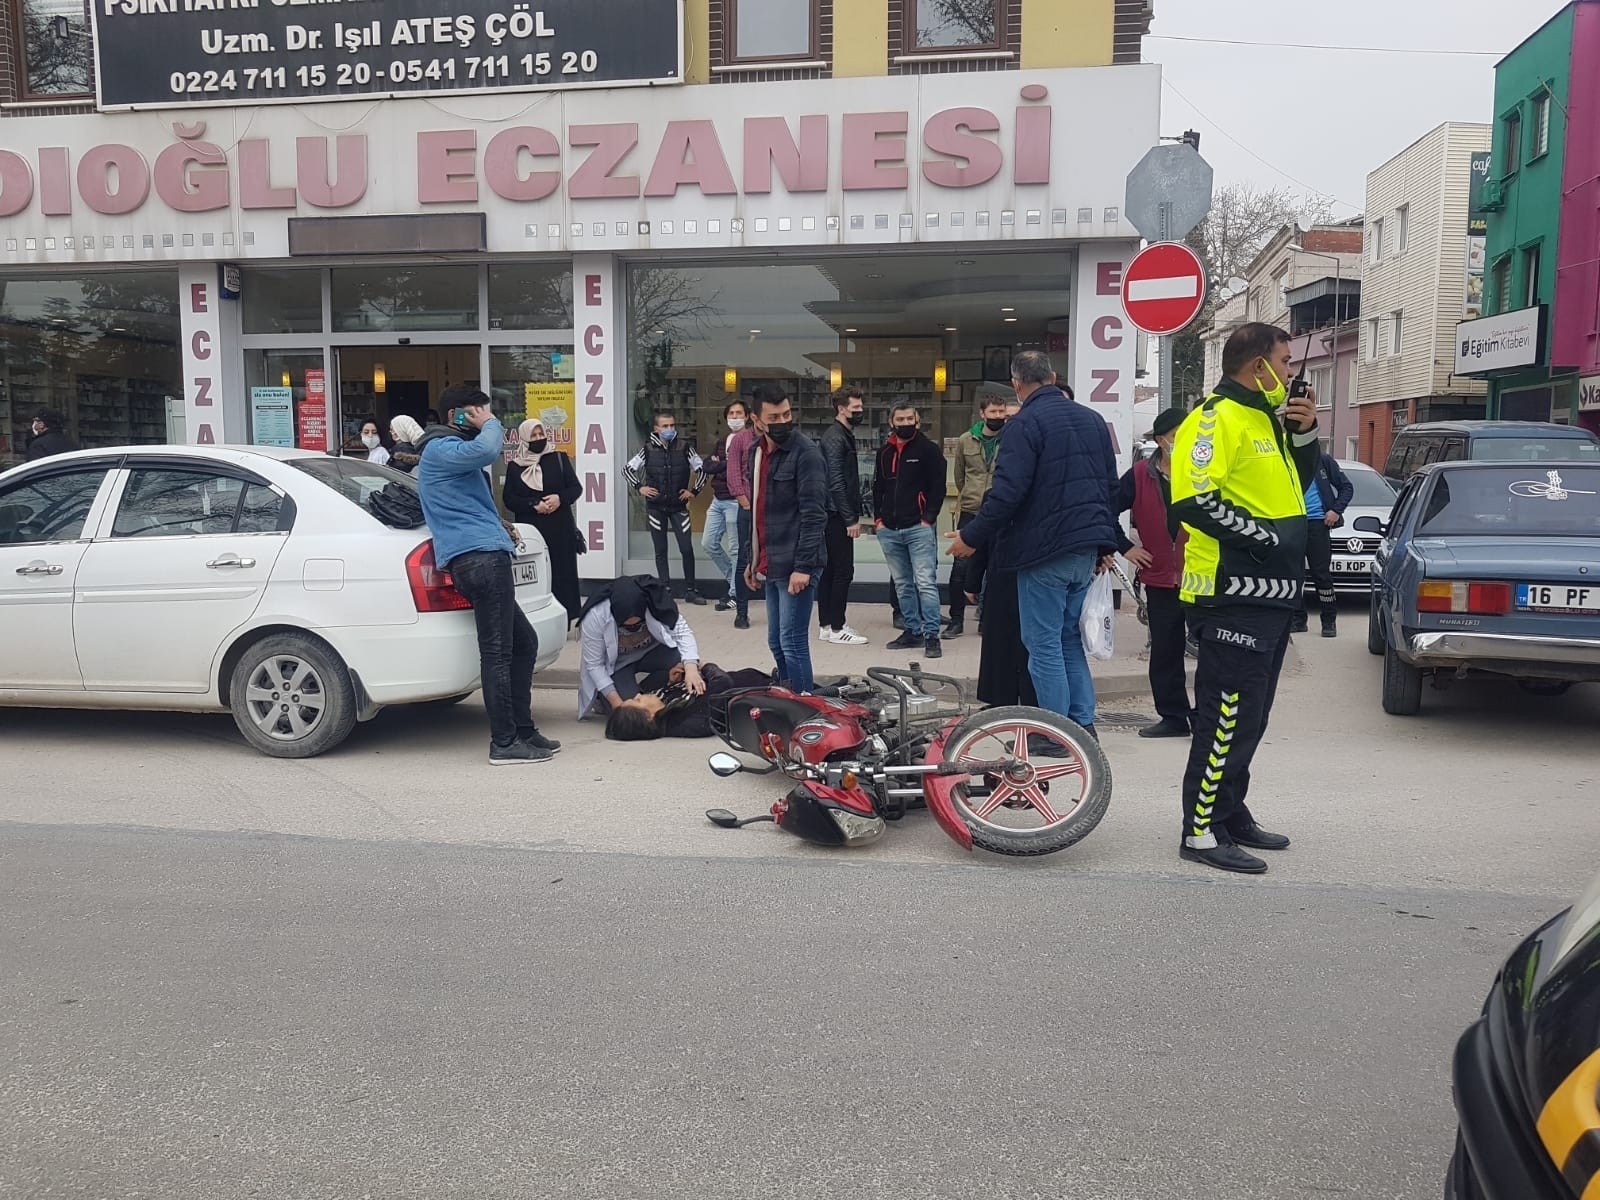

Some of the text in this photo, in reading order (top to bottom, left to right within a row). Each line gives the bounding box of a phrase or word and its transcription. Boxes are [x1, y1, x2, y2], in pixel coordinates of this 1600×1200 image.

[201, 4, 555, 54] Uzm. Dr. Işıl ATEŞ ÇÖL
[170, 69, 237, 93] 0224
[244, 67, 286, 90] 711
[296, 65, 326, 88] 15
[465, 55, 509, 79] 711
[520, 52, 551, 76] 15
[561, 50, 598, 74] 20
[417, 84, 1052, 203] ECZANESİ
[1471, 335, 1530, 358] Eğitim Kitabevi
[583, 274, 607, 551] ECZANE
[1346, 561, 1366, 571] KOP
[1529, 587, 1590, 606] 16 PF
